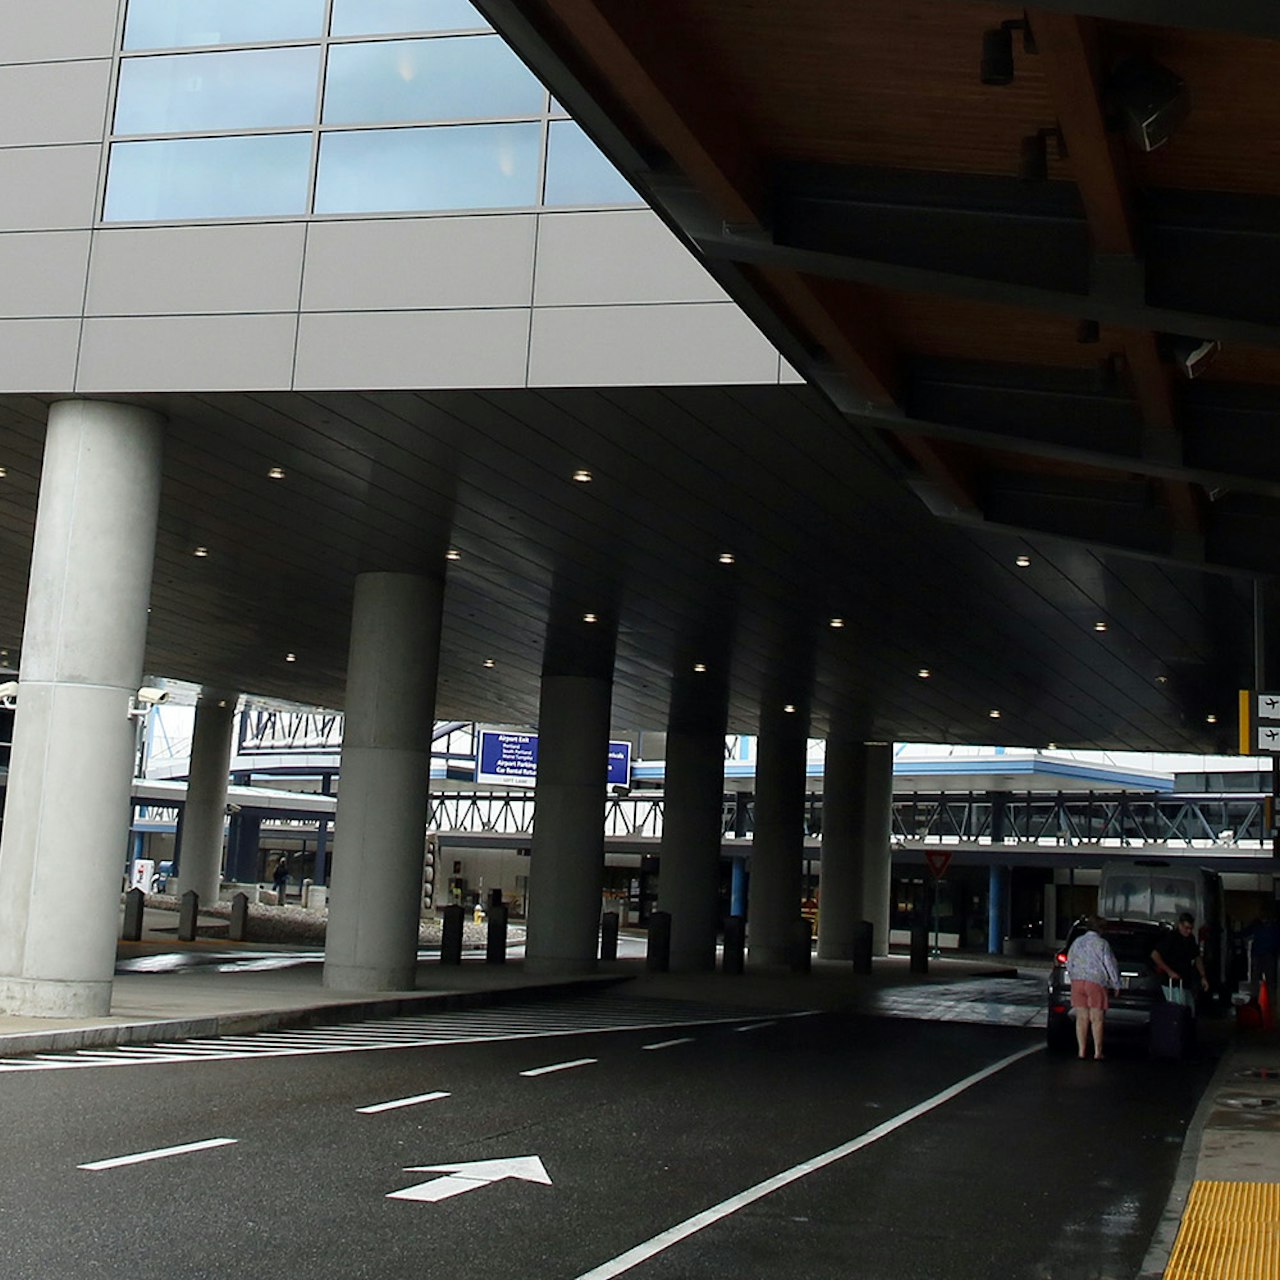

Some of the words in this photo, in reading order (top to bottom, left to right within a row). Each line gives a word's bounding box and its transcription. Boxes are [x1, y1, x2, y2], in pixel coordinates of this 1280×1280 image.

[498, 735, 518, 743] Airport
[496, 760, 517, 768] Airport
[517, 761, 537, 770] Parking
